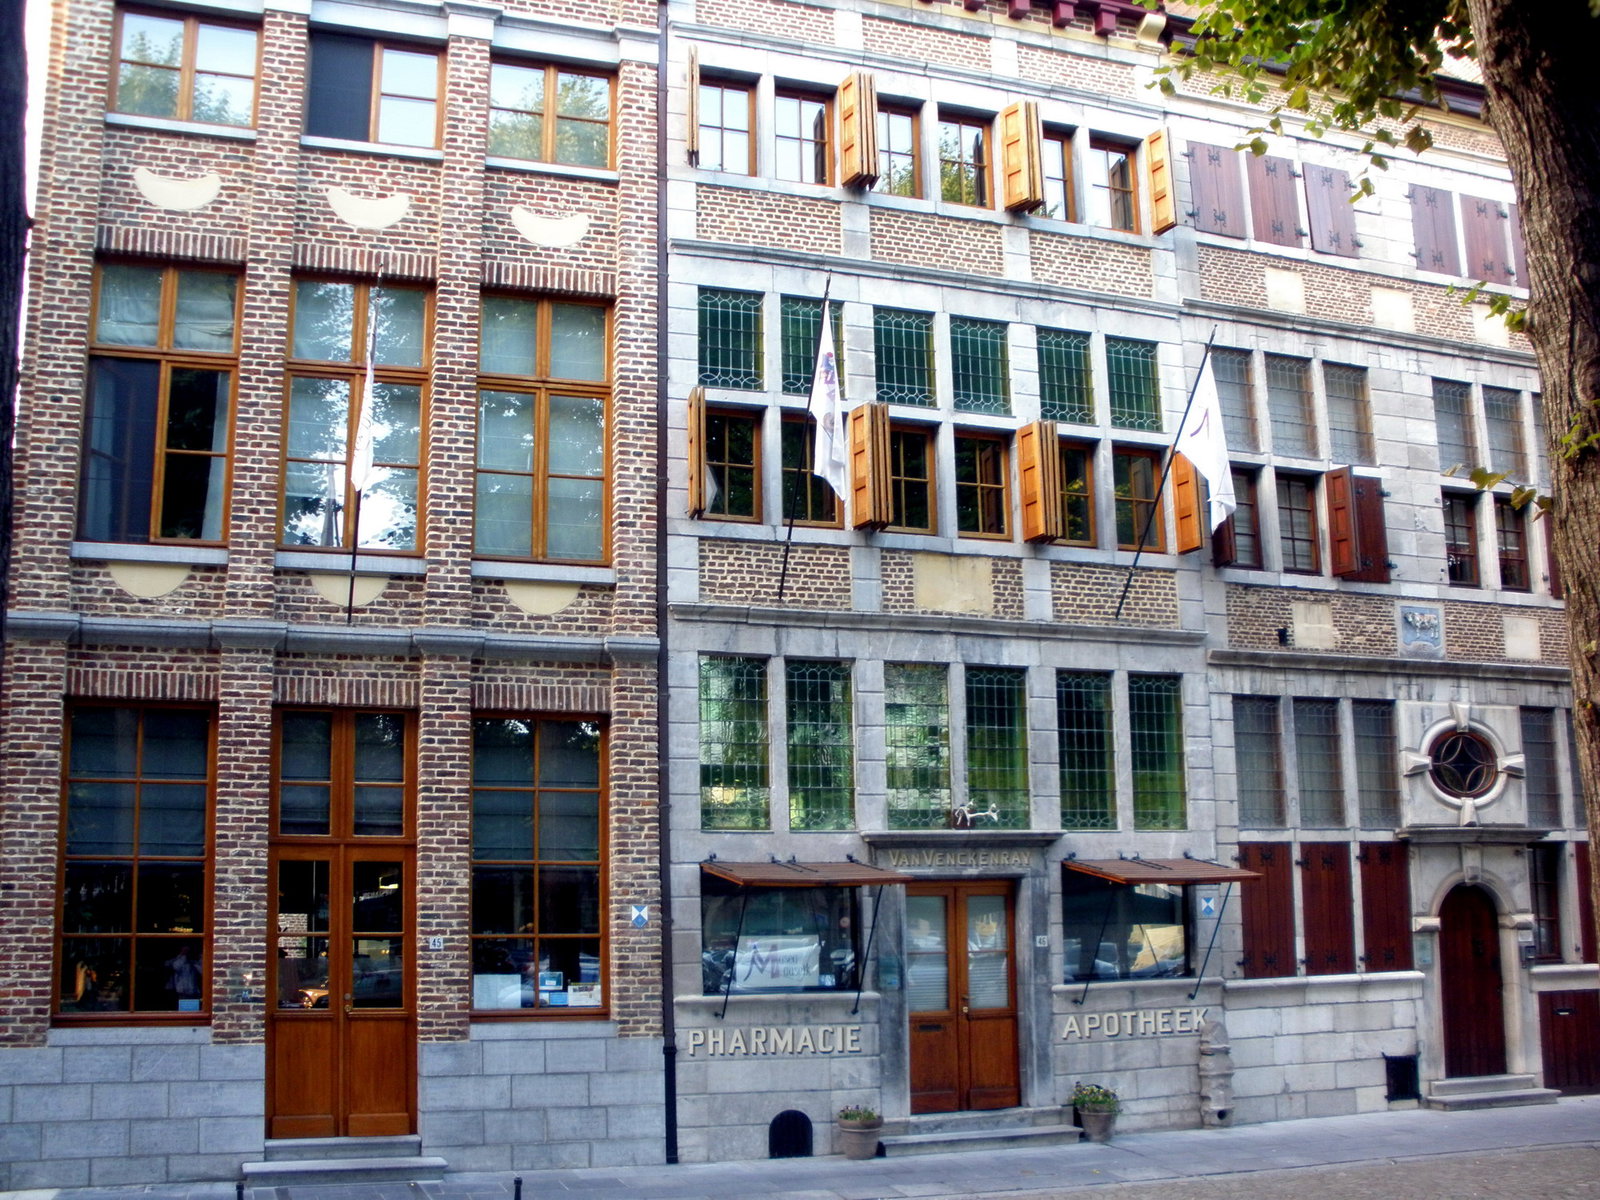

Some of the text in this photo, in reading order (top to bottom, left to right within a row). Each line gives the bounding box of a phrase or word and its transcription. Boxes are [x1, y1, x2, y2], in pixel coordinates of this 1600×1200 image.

[889, 850, 920, 867] VAN
[431, 938, 441, 948] 45
[1062, 1008, 1208, 1040] APOTHEEK
[688, 1025, 862, 1057] PHARMACIE
